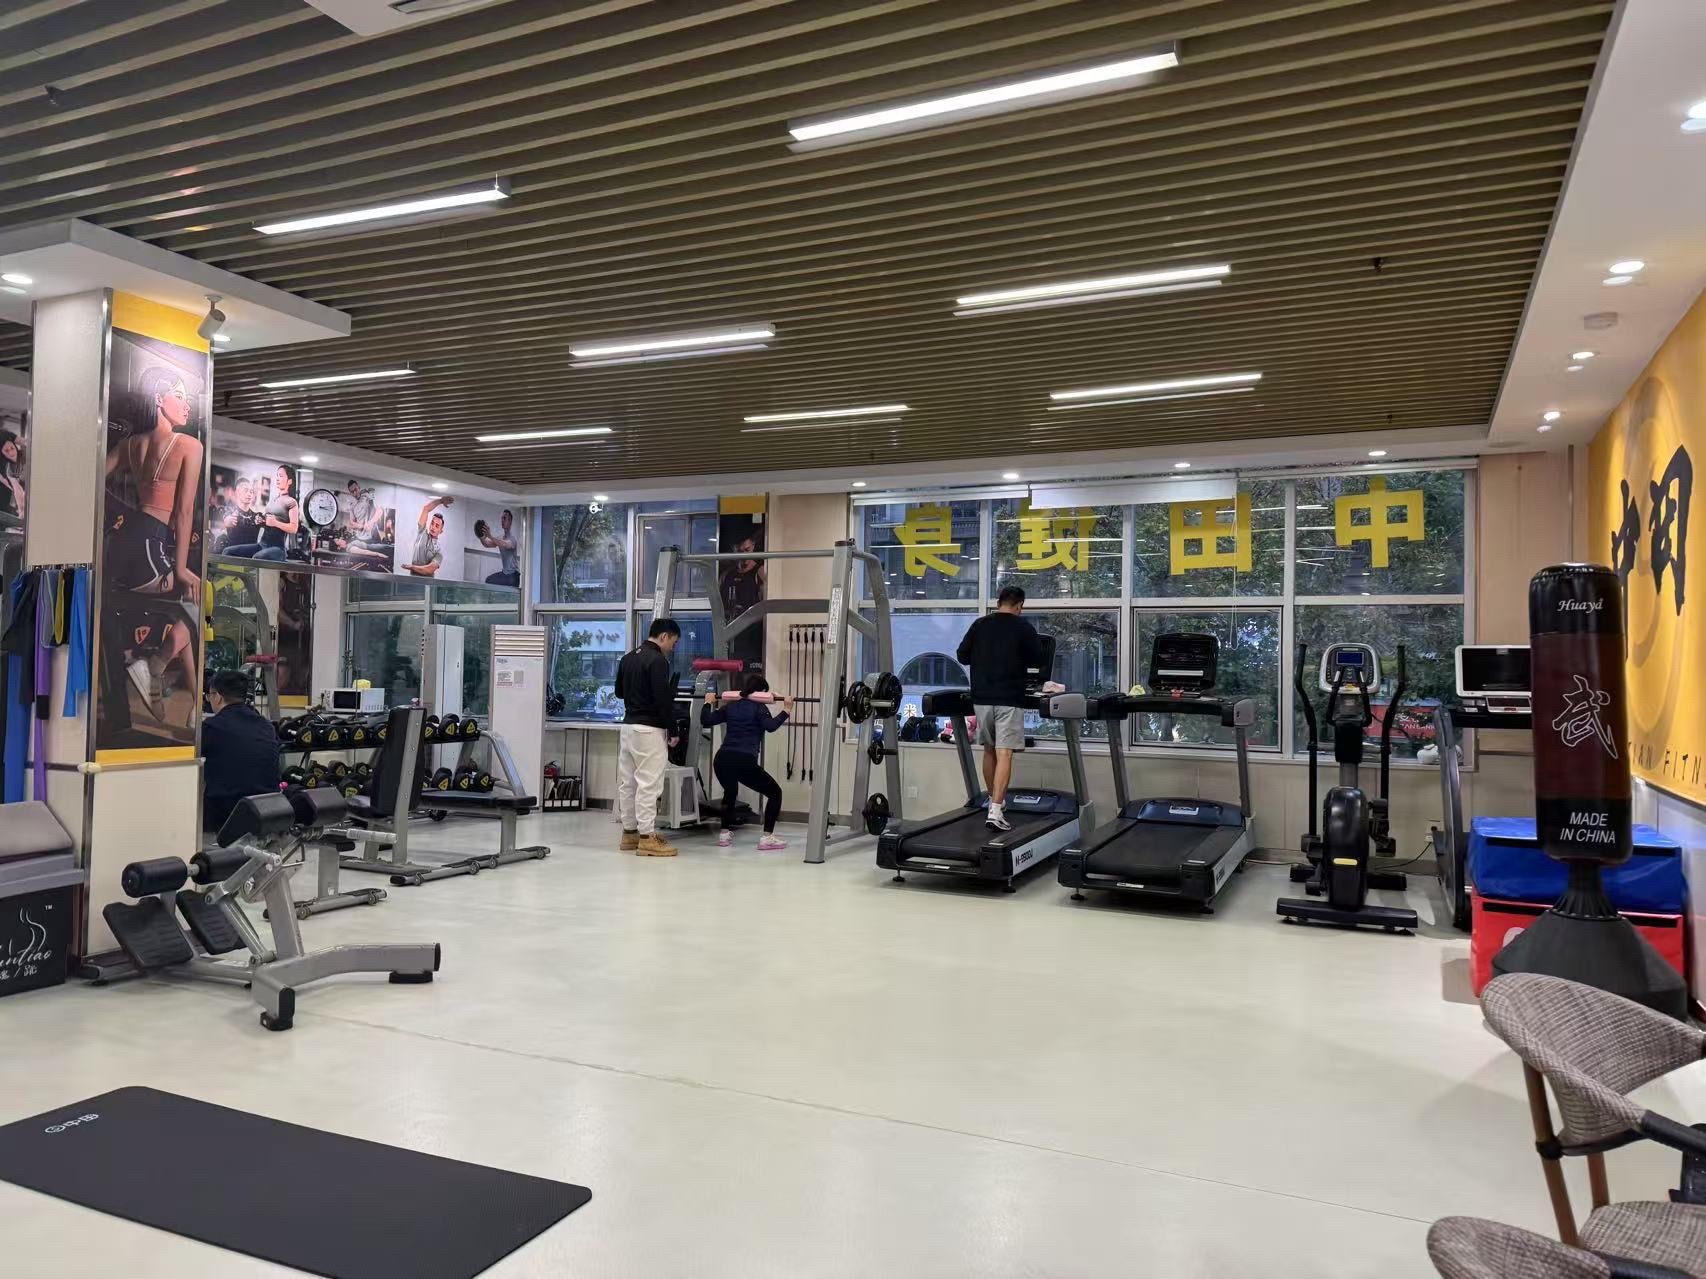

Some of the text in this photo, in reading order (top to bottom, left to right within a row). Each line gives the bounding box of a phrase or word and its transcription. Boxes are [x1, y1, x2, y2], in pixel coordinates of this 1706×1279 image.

[1552, 674, 1619, 760] 武
[1628, 740, 1706, 789] IAN FITN
[1569, 811, 1608, 827] MADE
[1560, 828, 1616, 843] IN CHINA
